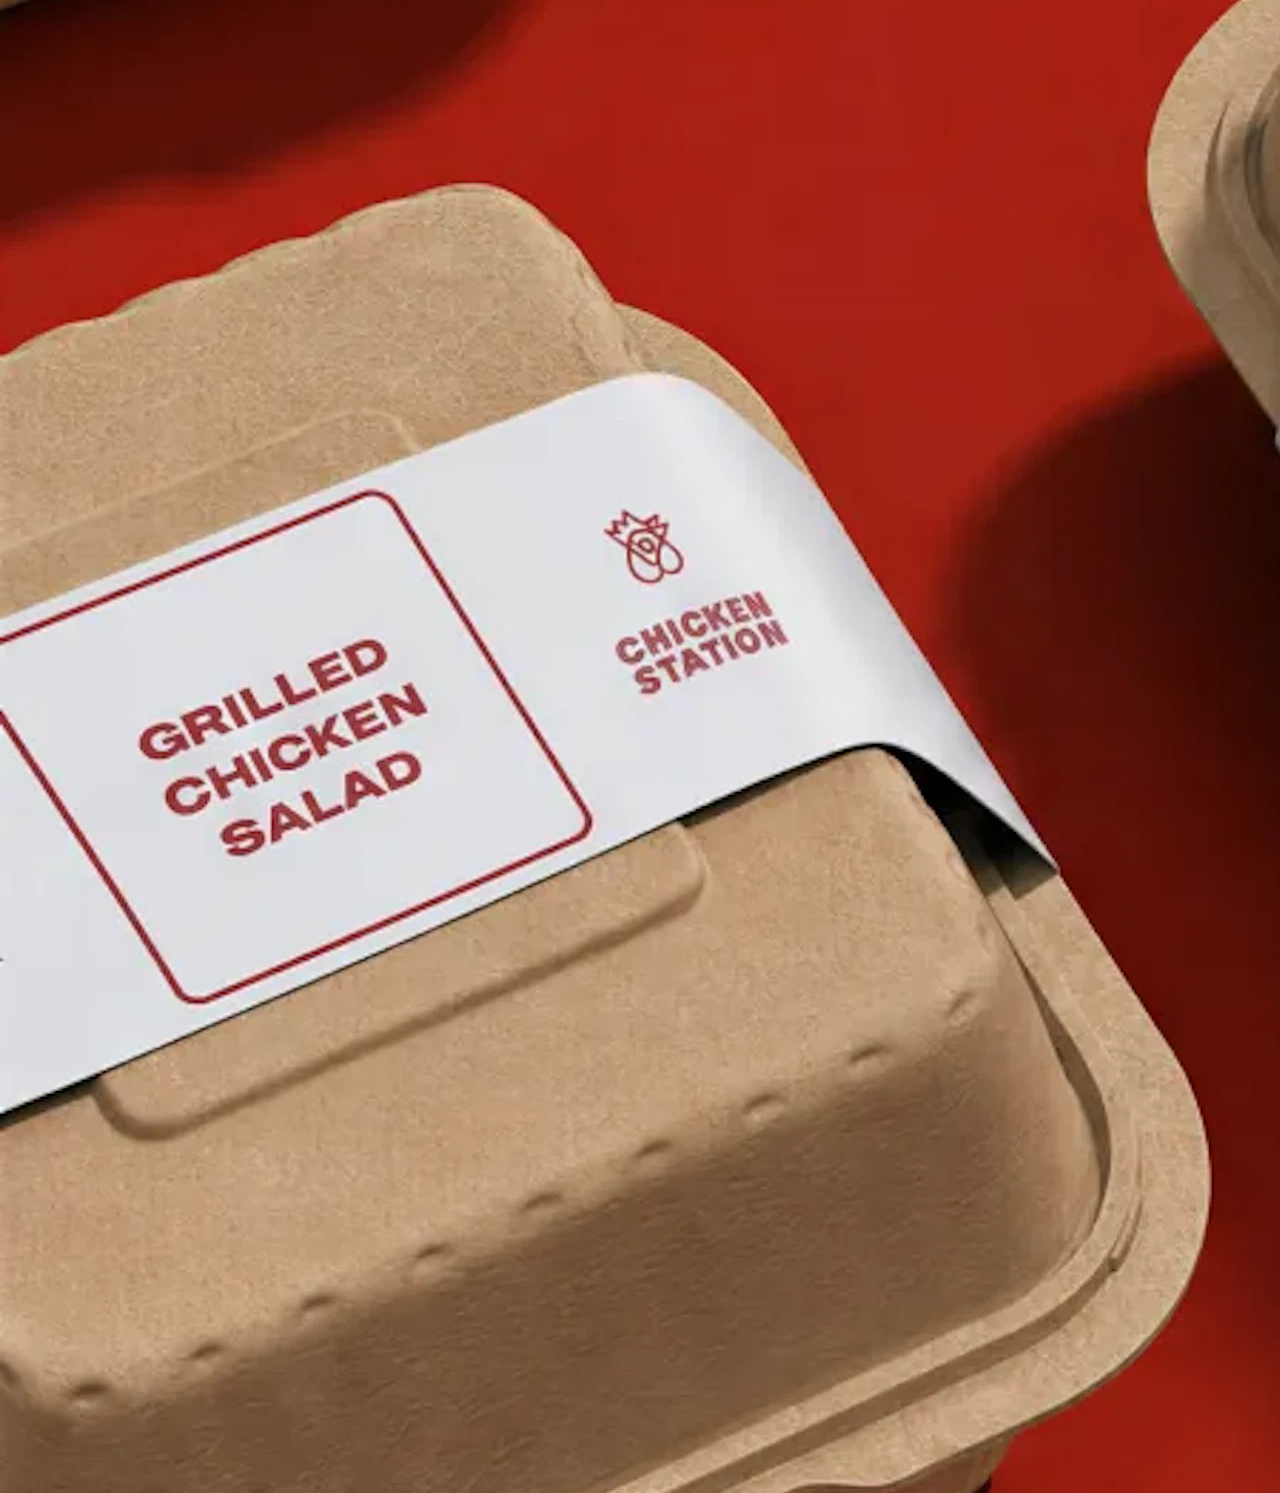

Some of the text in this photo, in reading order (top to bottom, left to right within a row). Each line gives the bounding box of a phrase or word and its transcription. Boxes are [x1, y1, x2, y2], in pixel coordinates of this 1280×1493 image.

[615, 591, 773, 665] CHICKEN
[634, 620, 789, 697] STATION
[137, 637, 389, 762] GRILLED
[164, 681, 428, 816] CHICKEN
[220, 750, 422, 857] SALAD
